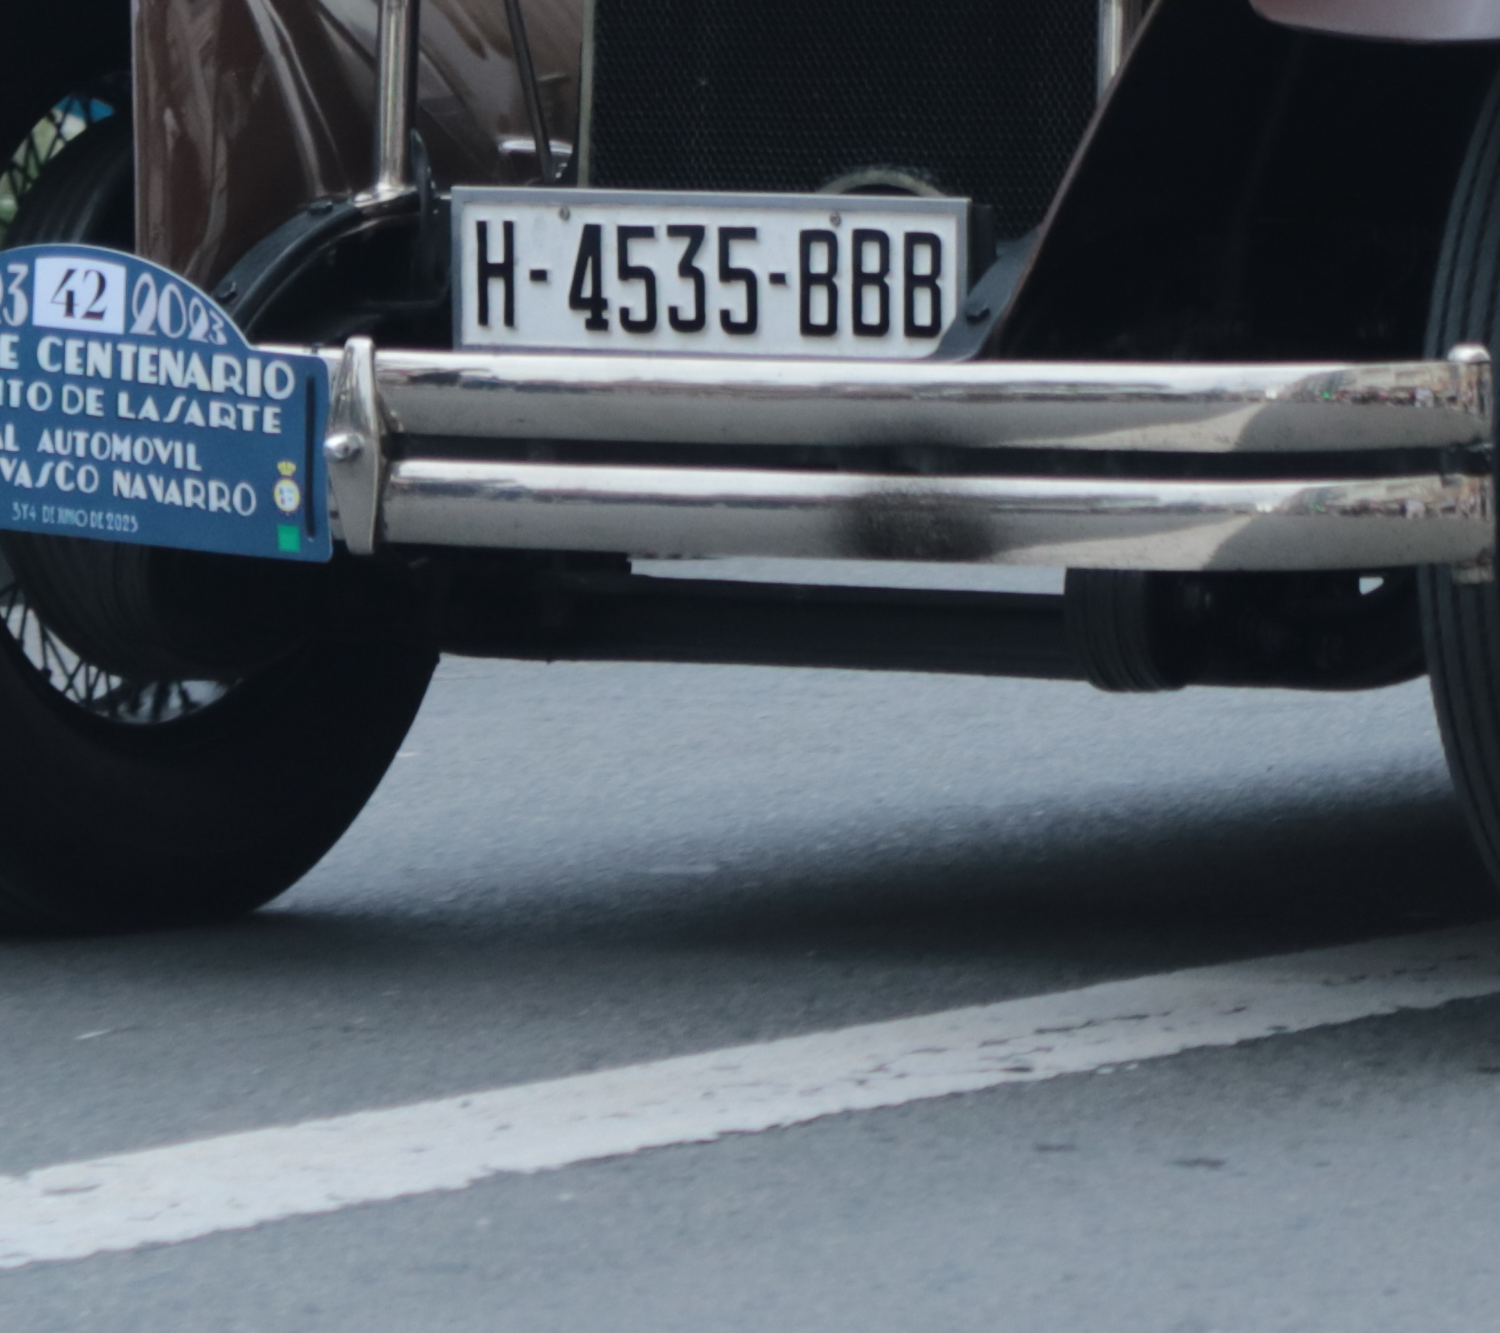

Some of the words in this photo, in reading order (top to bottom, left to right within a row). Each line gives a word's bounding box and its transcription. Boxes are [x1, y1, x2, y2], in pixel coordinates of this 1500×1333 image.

[51, 268, 108, 321] 42
[476, 220, 942, 339] H-4535-BBB
[129, 272, 228, 345] 2023
[36, 335, 296, 400] CENTENARIO
[62, 384, 105, 417] DE
[36, 428, 202, 472] AUTOMOVIL
[112, 468, 257, 517] NAVARRO
